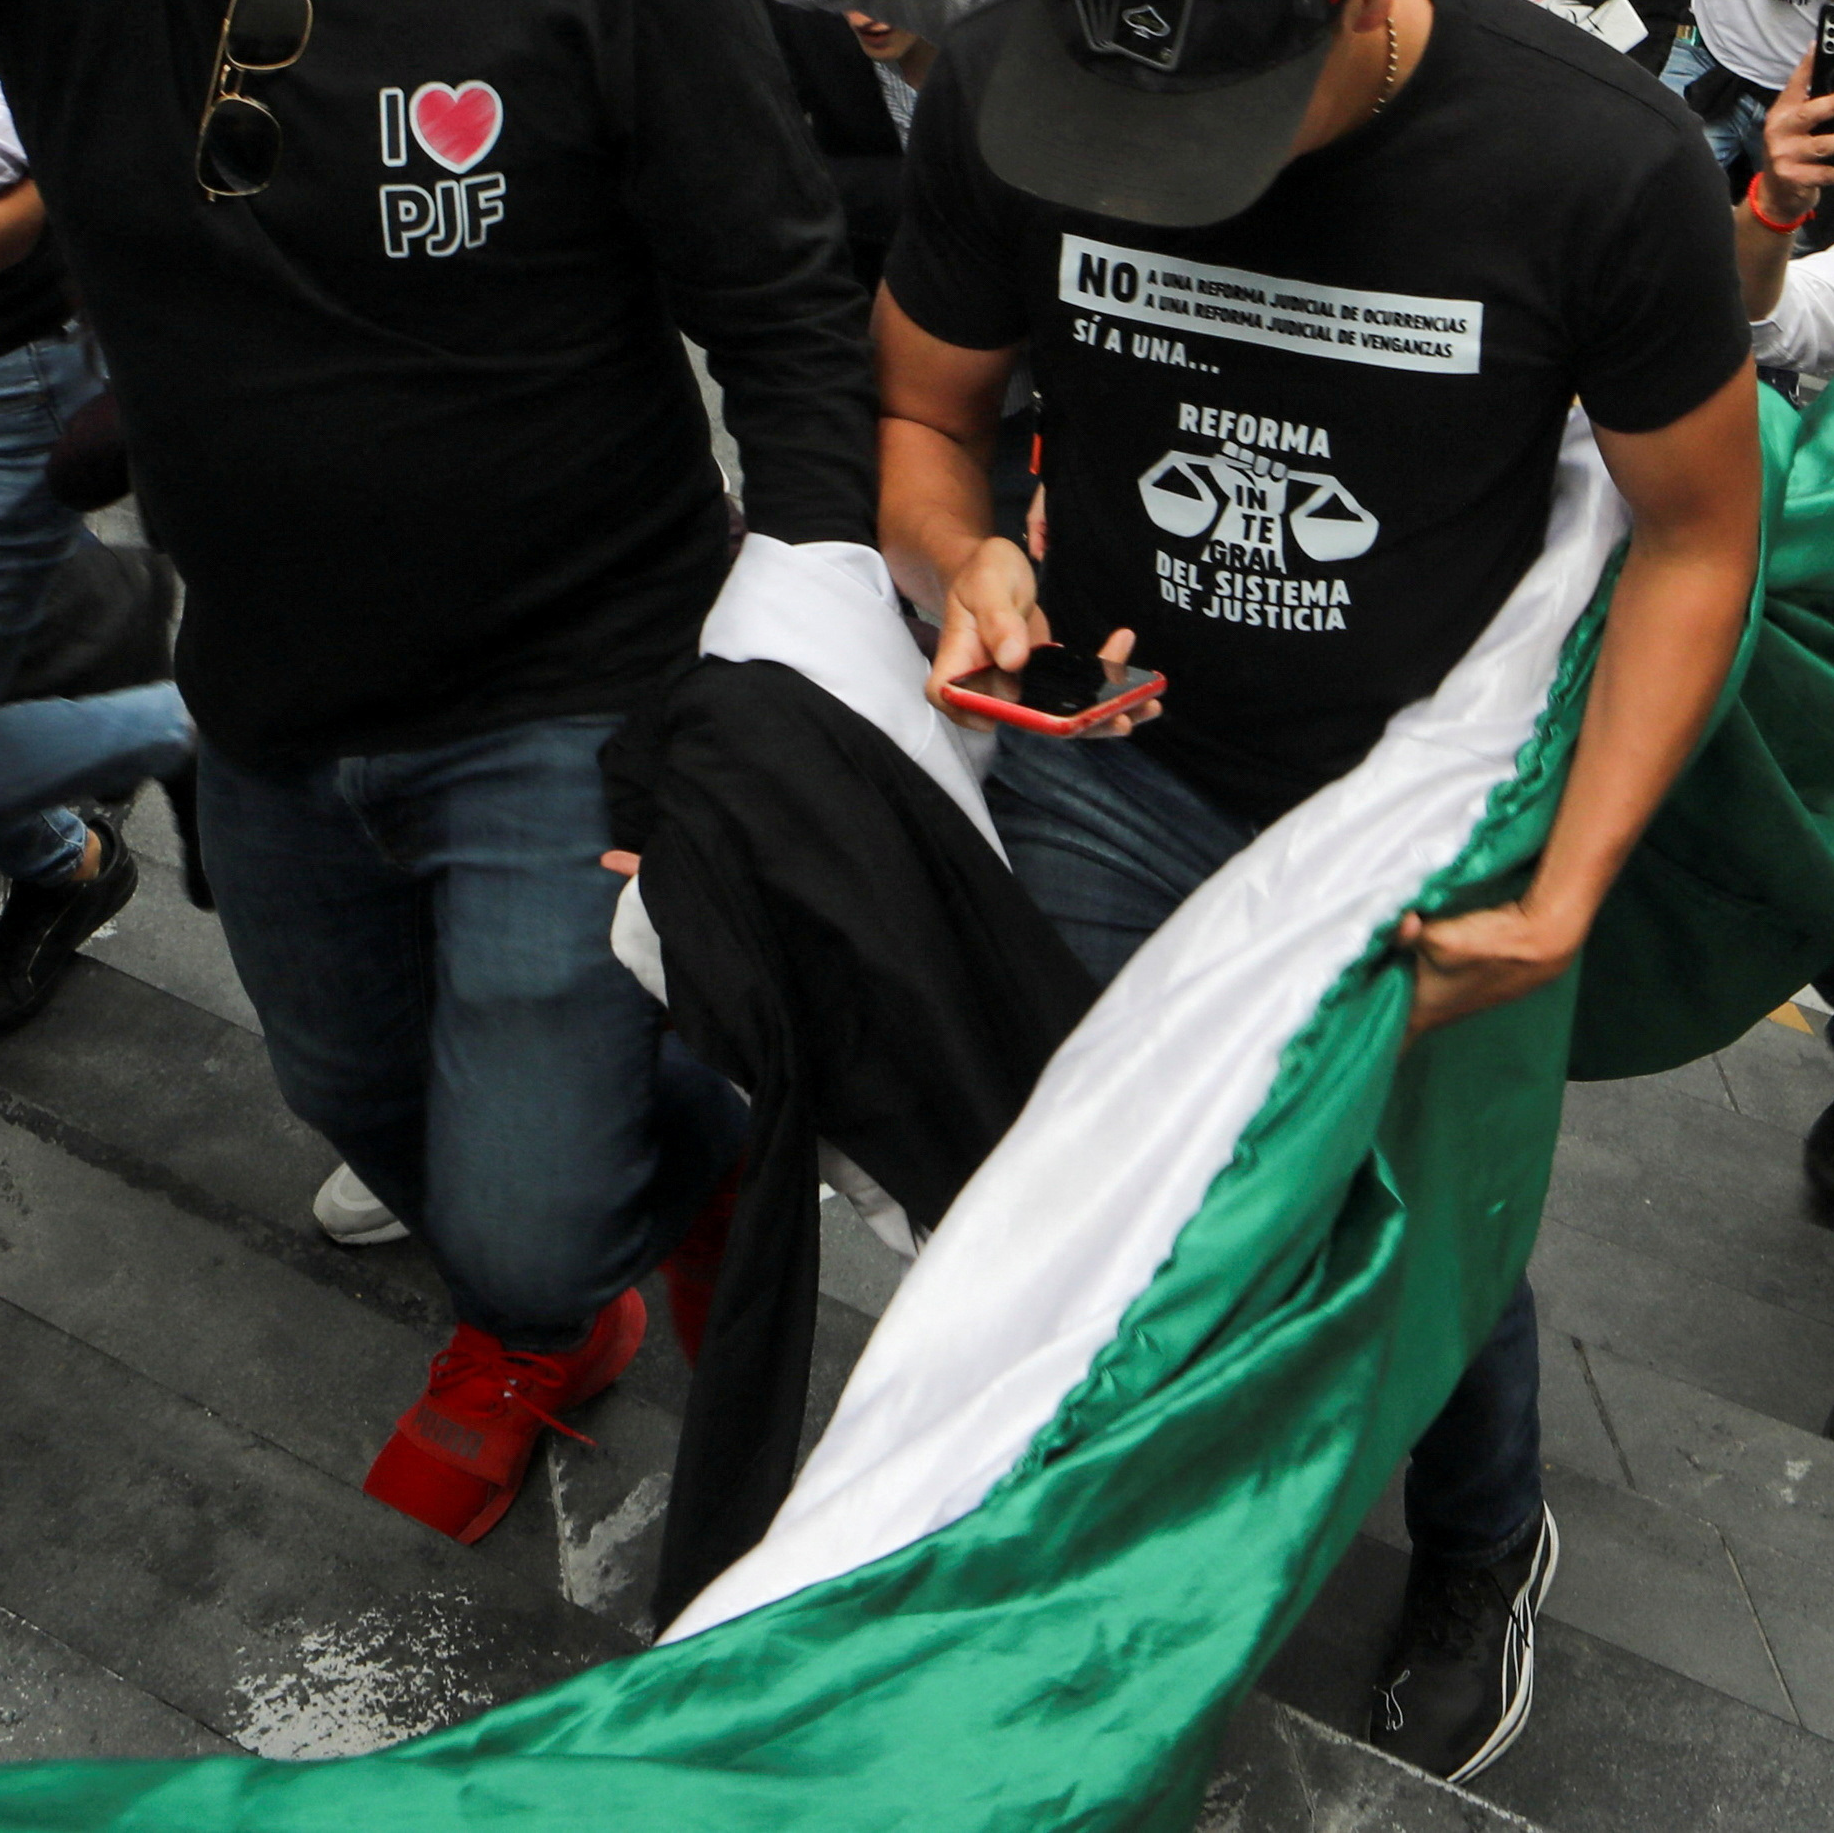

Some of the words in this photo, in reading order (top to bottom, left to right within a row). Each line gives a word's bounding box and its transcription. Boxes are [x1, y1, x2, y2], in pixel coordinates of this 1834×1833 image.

[379, 87, 407, 167] I
[379, 172, 507, 258] PJF
[1077, 252, 1139, 304] NO
[1146, 269, 1158, 286] A
[1161, 271, 1193, 294] UNA
[1197, 278, 1267, 306] REFORMA
[1269, 291, 1335, 319] JUDICIAL
[1341, 303, 1361, 323] DE
[1363, 307, 1467, 335] OCURRENCIAS
[1073, 314, 1099, 346] SÍ
[1104, 329, 1124, 354] A
[1132, 333, 1221, 374] UNA...
[1144, 293, 1157, 310] A
[1159, 295, 1190, 317] UNA
[1193, 301, 1264, 330] REFORMA
[1266, 313, 1333, 342] JUDICIAL
[1337, 327, 1357, 347] DE
[1360, 330, 1453, 359] VENGANZAS
[1178, 402, 1331, 459] REFORMA
[1235, 484, 1267, 511] IN
[1208, 539, 1282, 576] GRAL
[1241, 513, 1275, 545] TE
[1156, 549, 1202, 592] DEL
[1215, 569, 1351, 606] SISTEMA
[1160, 579, 1192, 611] DE
[1203, 596, 1347, 632] JUSTICIA
